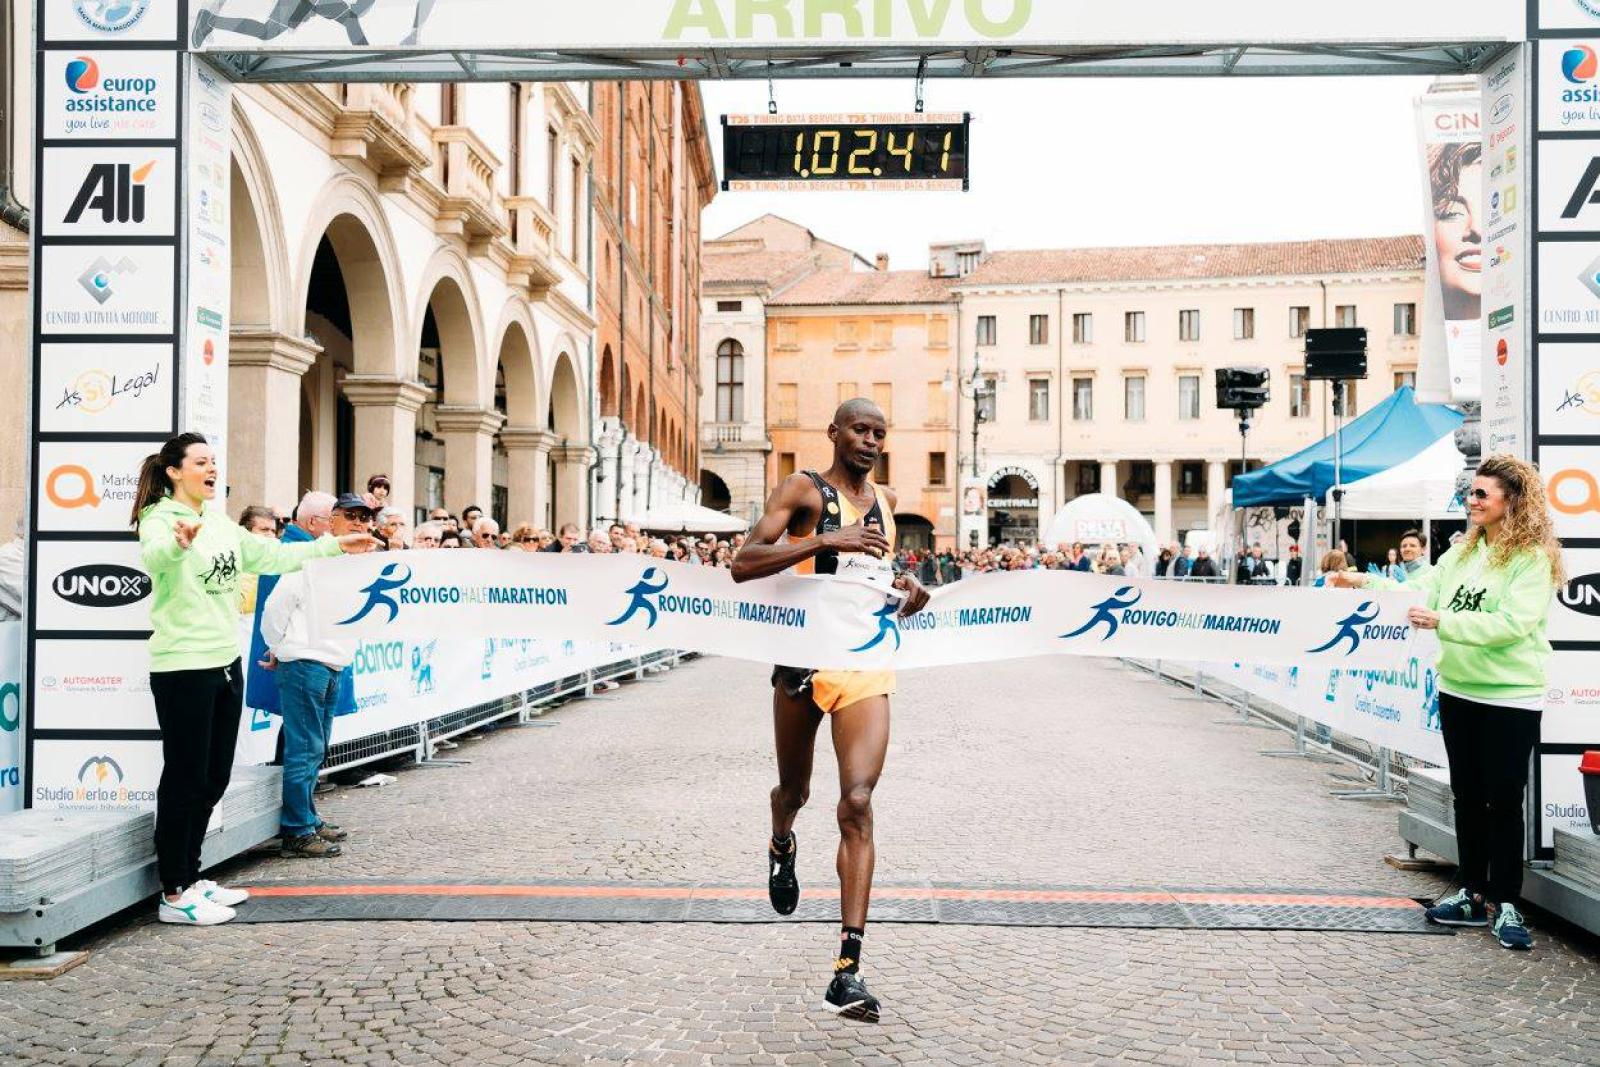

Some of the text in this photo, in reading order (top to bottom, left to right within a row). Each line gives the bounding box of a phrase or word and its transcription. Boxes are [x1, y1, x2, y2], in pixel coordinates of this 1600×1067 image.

[661, 0, 1033, 39] ARRIVO
[103, 76, 156, 95] europ
[1562, 84, 1600, 102] assi
[66, 95, 156, 112] assistance
[65, 119, 87, 133] you
[90, 116, 110, 129] live
[754, 114, 783, 124] TIMING
[786, 114, 807, 124] DATA
[809, 114, 843, 124] SERVICE
[871, 114, 902, 123] TIMING
[904, 114, 924, 123] DATA
[926, 114, 961, 123] SERVICE
[1434, 112, 1480, 130] CiN
[1561, 110, 1585, 125] you
[63, 160, 157, 223] Ali
[787, 181, 808, 191] DATA
[810, 181, 843, 191] SERVICE
[904, 181, 924, 191] DATA
[926, 181, 961, 191] SERVICE
[46, 311, 80, 324] CENTRO
[121, 311, 160, 324] MOTORIE
[1543, 309, 1581, 323] CENTRO
[112, 362, 159, 398] Legal
[102, 474, 140, 486] Marke
[57, 575, 142, 596] UNOX
[1562, 584, 1600, 605] UN
[63, 676, 122, 685] AUTOMASTER
[1571, 689, 1600, 697] AUTO
[36, 787, 156, 801] Studio Merlo e Becca
[1545, 803, 1587, 818] Studio
